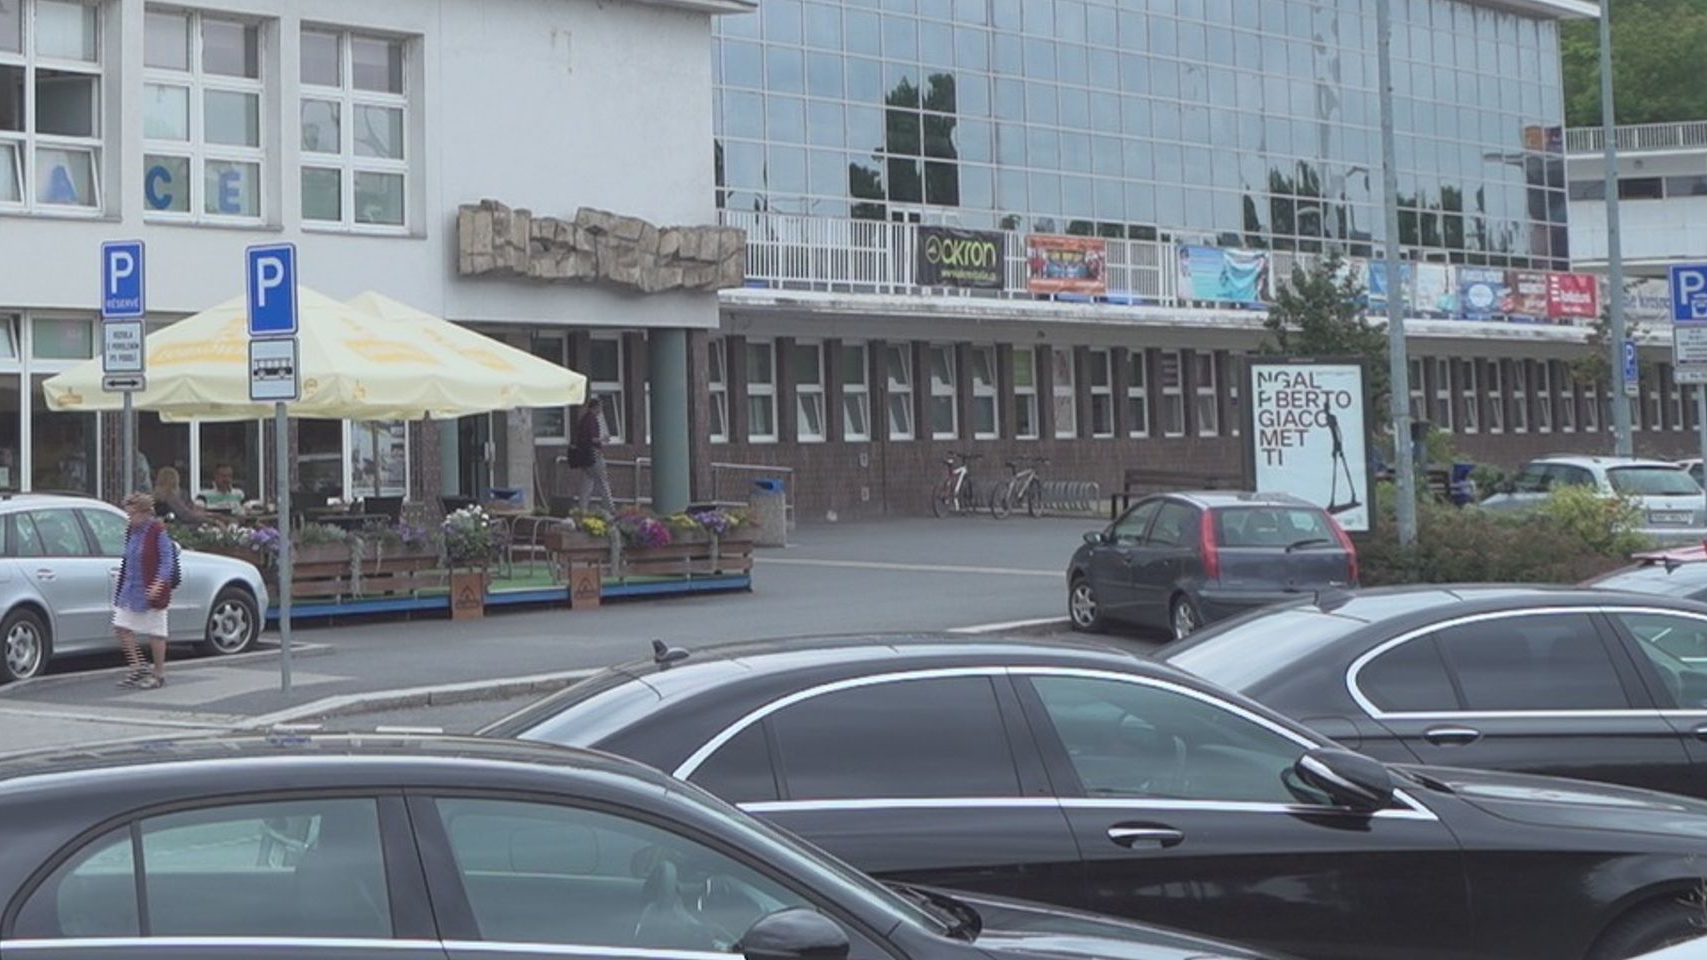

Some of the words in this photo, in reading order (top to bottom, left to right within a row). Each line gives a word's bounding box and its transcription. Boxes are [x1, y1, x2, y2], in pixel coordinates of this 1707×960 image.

[942, 239, 997, 268] akron
[111, 251, 134, 294] P
[257, 257, 284, 307] P
[1679, 271, 1706, 306] P
[1258, 409, 1330, 428] GIACO
[1260, 429, 1309, 447] MET
[1261, 448, 1283, 466] TI
